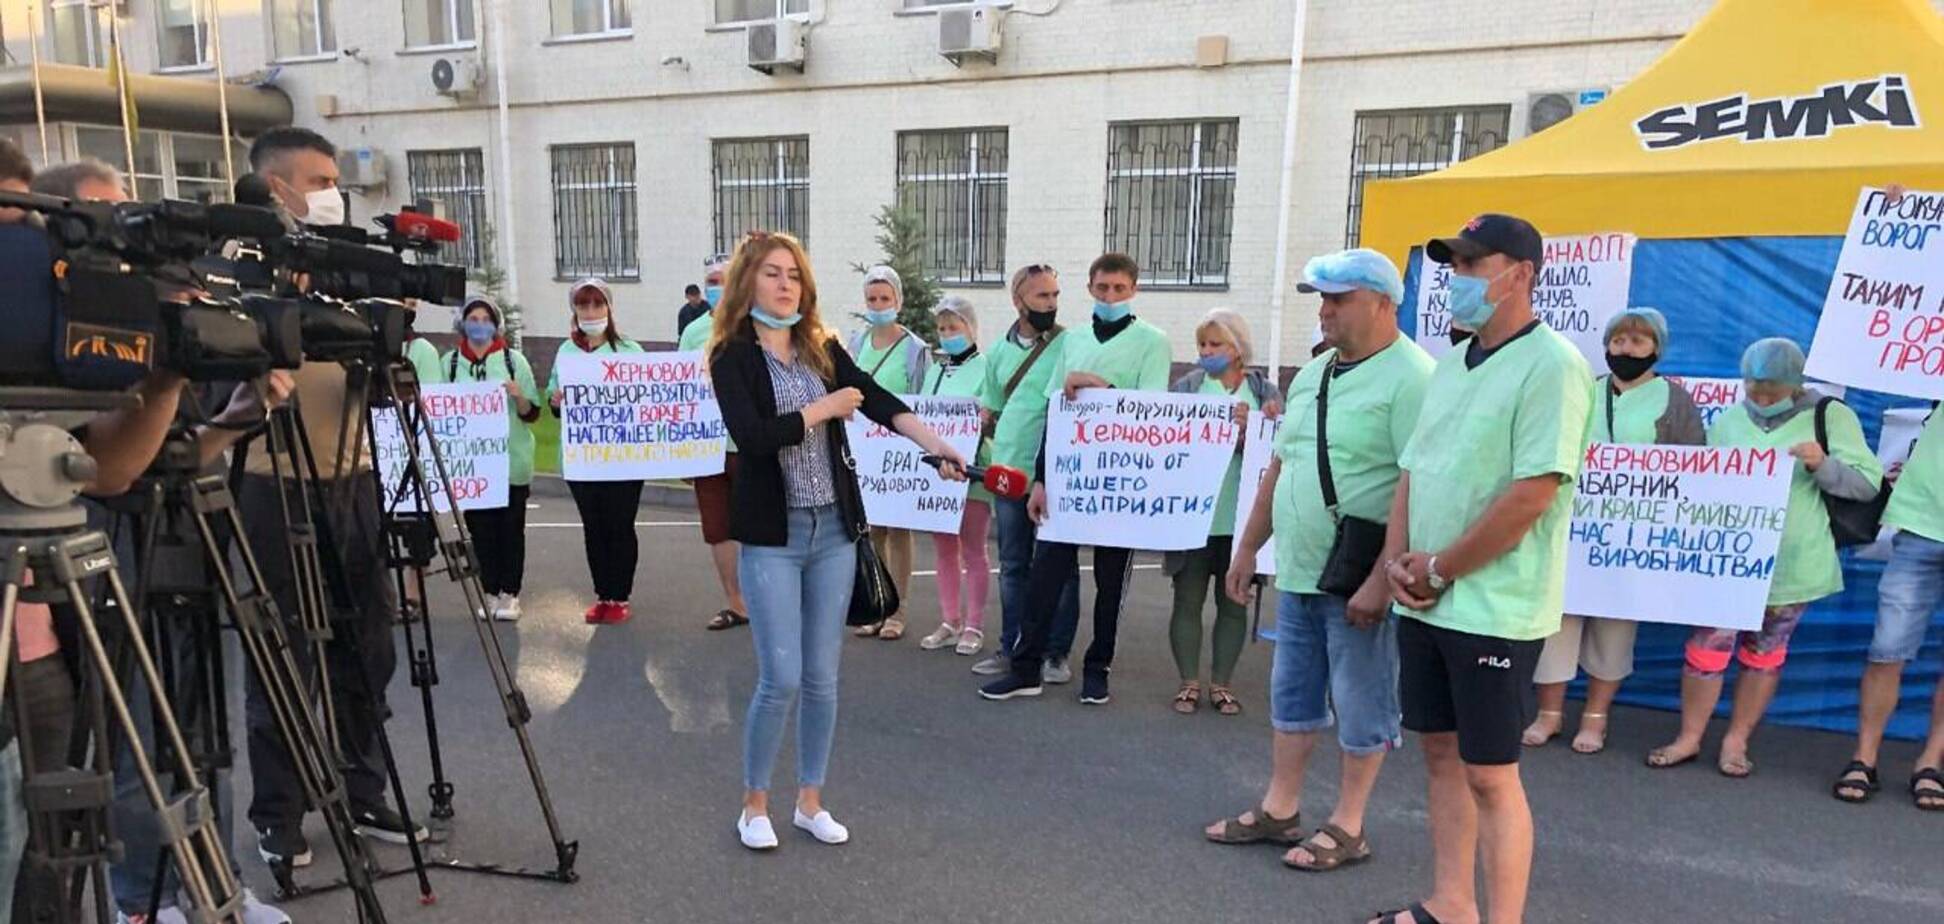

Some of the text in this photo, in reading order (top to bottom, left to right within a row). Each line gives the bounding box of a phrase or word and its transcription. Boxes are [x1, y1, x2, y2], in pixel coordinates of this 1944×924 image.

[1863, 189, 1944, 222] ПРОКУ
[1862, 219, 1941, 251] ВОРОГ
[1543, 241, 1585, 263] АНА
[1531, 288, 1577, 309] РНУВ.
[1842, 272, 1924, 311] ТАКИМ
[1869, 309, 1944, 344] В ОР
[1879, 341, 1944, 376] ПРО
[882, 450, 927, 473] ВРАГ
[1097, 451, 1154, 470] ПРОЧЬ
[860, 474, 930, 494] РУДОВОГО
[1066, 475, 1148, 492] НАШЕГО
[1600, 498, 1668, 524] КРАДЕ
[1647, 526, 1754, 554] НАШОГО
[1588, 546, 1775, 580] ВИРОБНИЦТВА!
